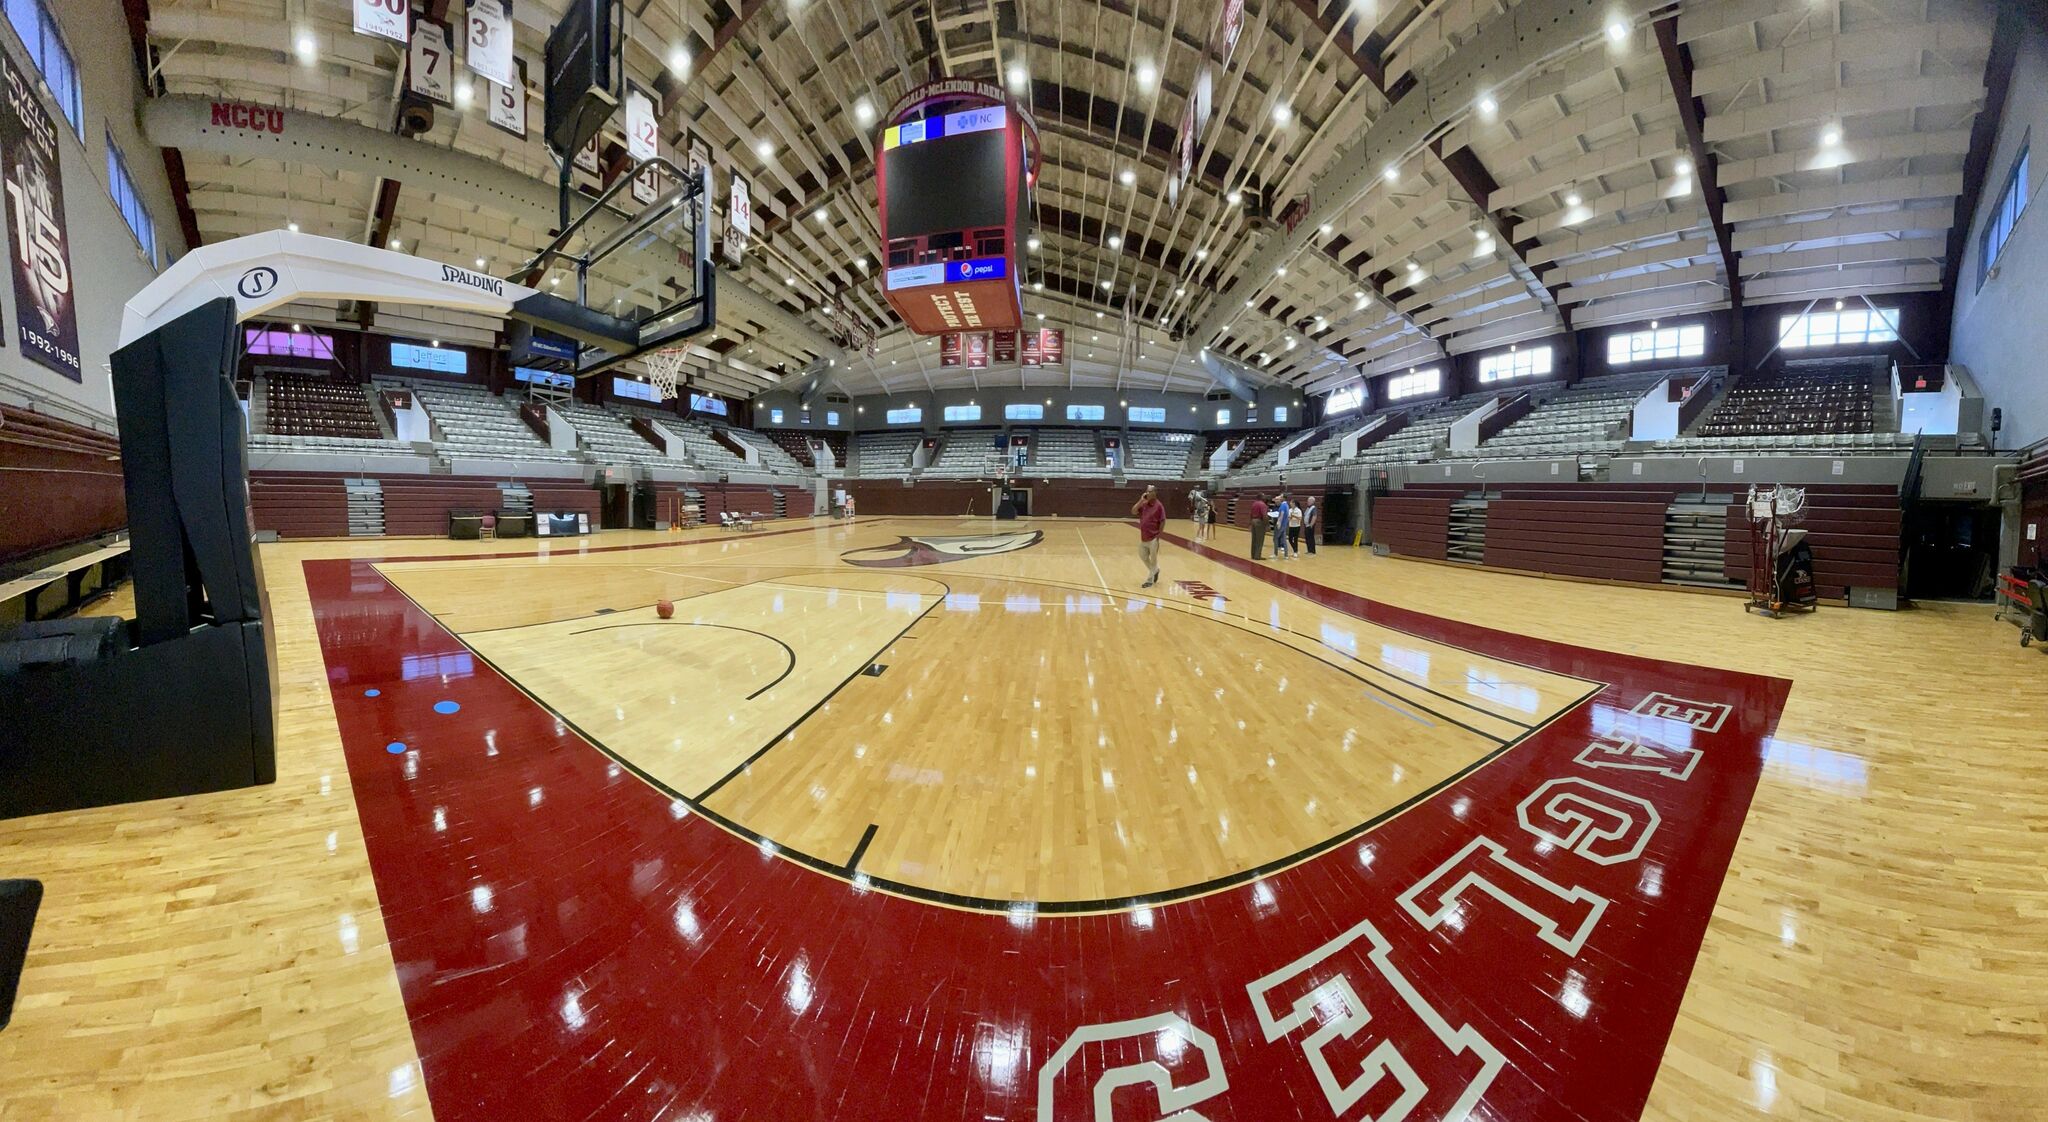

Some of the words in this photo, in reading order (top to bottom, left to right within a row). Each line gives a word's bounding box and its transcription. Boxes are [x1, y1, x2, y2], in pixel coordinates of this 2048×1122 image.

[422, 47, 439, 75] 7
[3, 58, 55, 146] LEVELLE
[501, 86, 515, 109] 5
[977, 82, 1006, 100] ARENA
[9, 89, 53, 160] MOTON
[211, 102, 284, 134] NCCU
[634, 117, 655, 147] 12
[980, 113, 992, 124] NC
[734, 195, 749, 220] 14
[7, 177, 69, 294] 15
[725, 227, 739, 248] 43
[441, 264, 503, 297] SPALDING
[974, 265, 993, 275] pepsi
[930, 294, 962, 328] PROTECT
[954, 291, 977, 314] NEST
[965, 314, 982, 327] THE
[22, 327, 79, 368] 1992-1996
